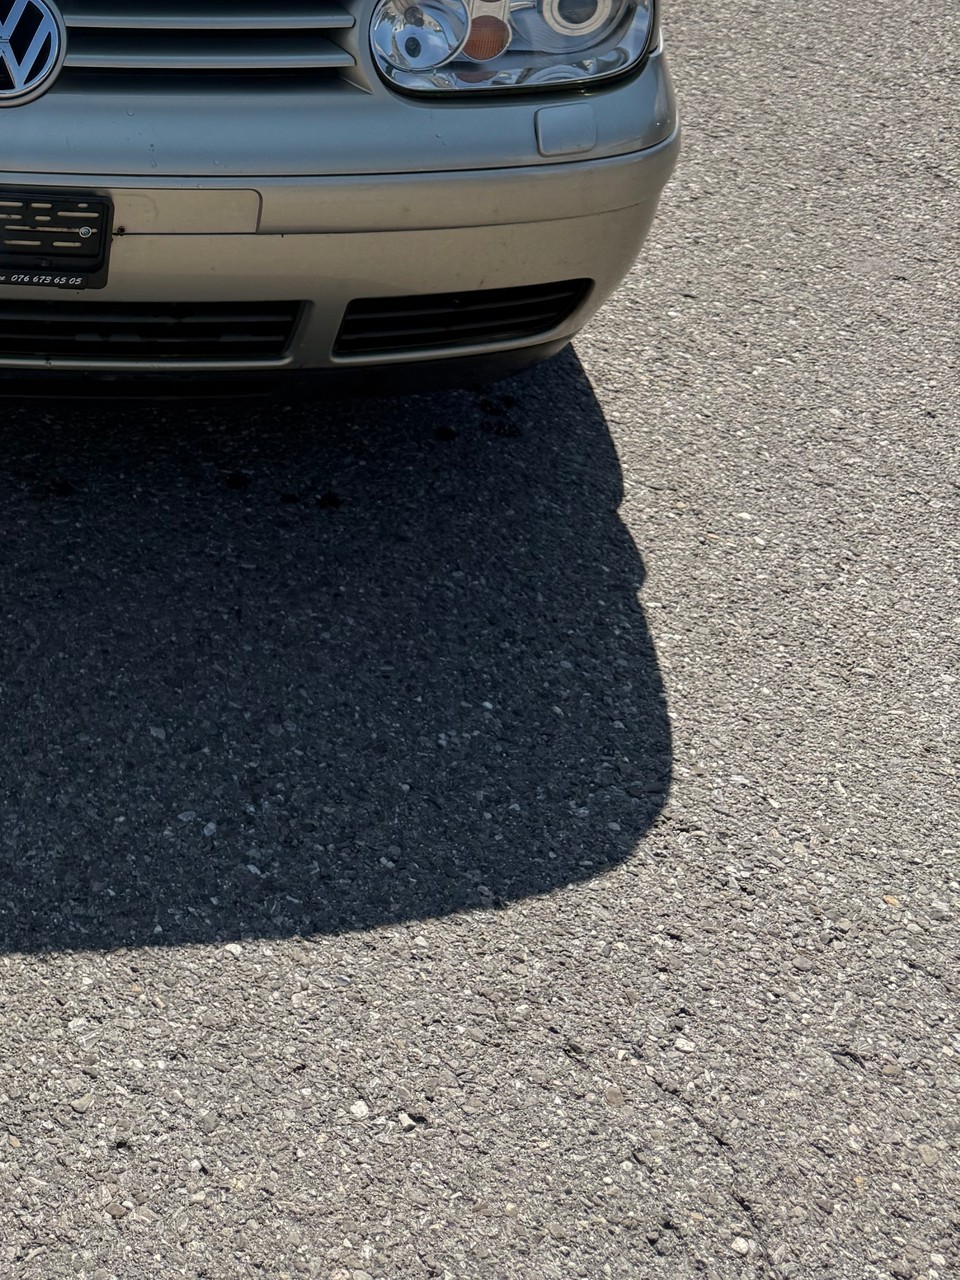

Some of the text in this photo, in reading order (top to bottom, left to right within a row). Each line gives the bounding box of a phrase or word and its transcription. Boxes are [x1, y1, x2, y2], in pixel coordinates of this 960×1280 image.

[10, 274, 29, 282] 076
[32, 275, 52, 283] 673
[53, 276, 66, 284] 65
[68, 277, 82, 285] 05
